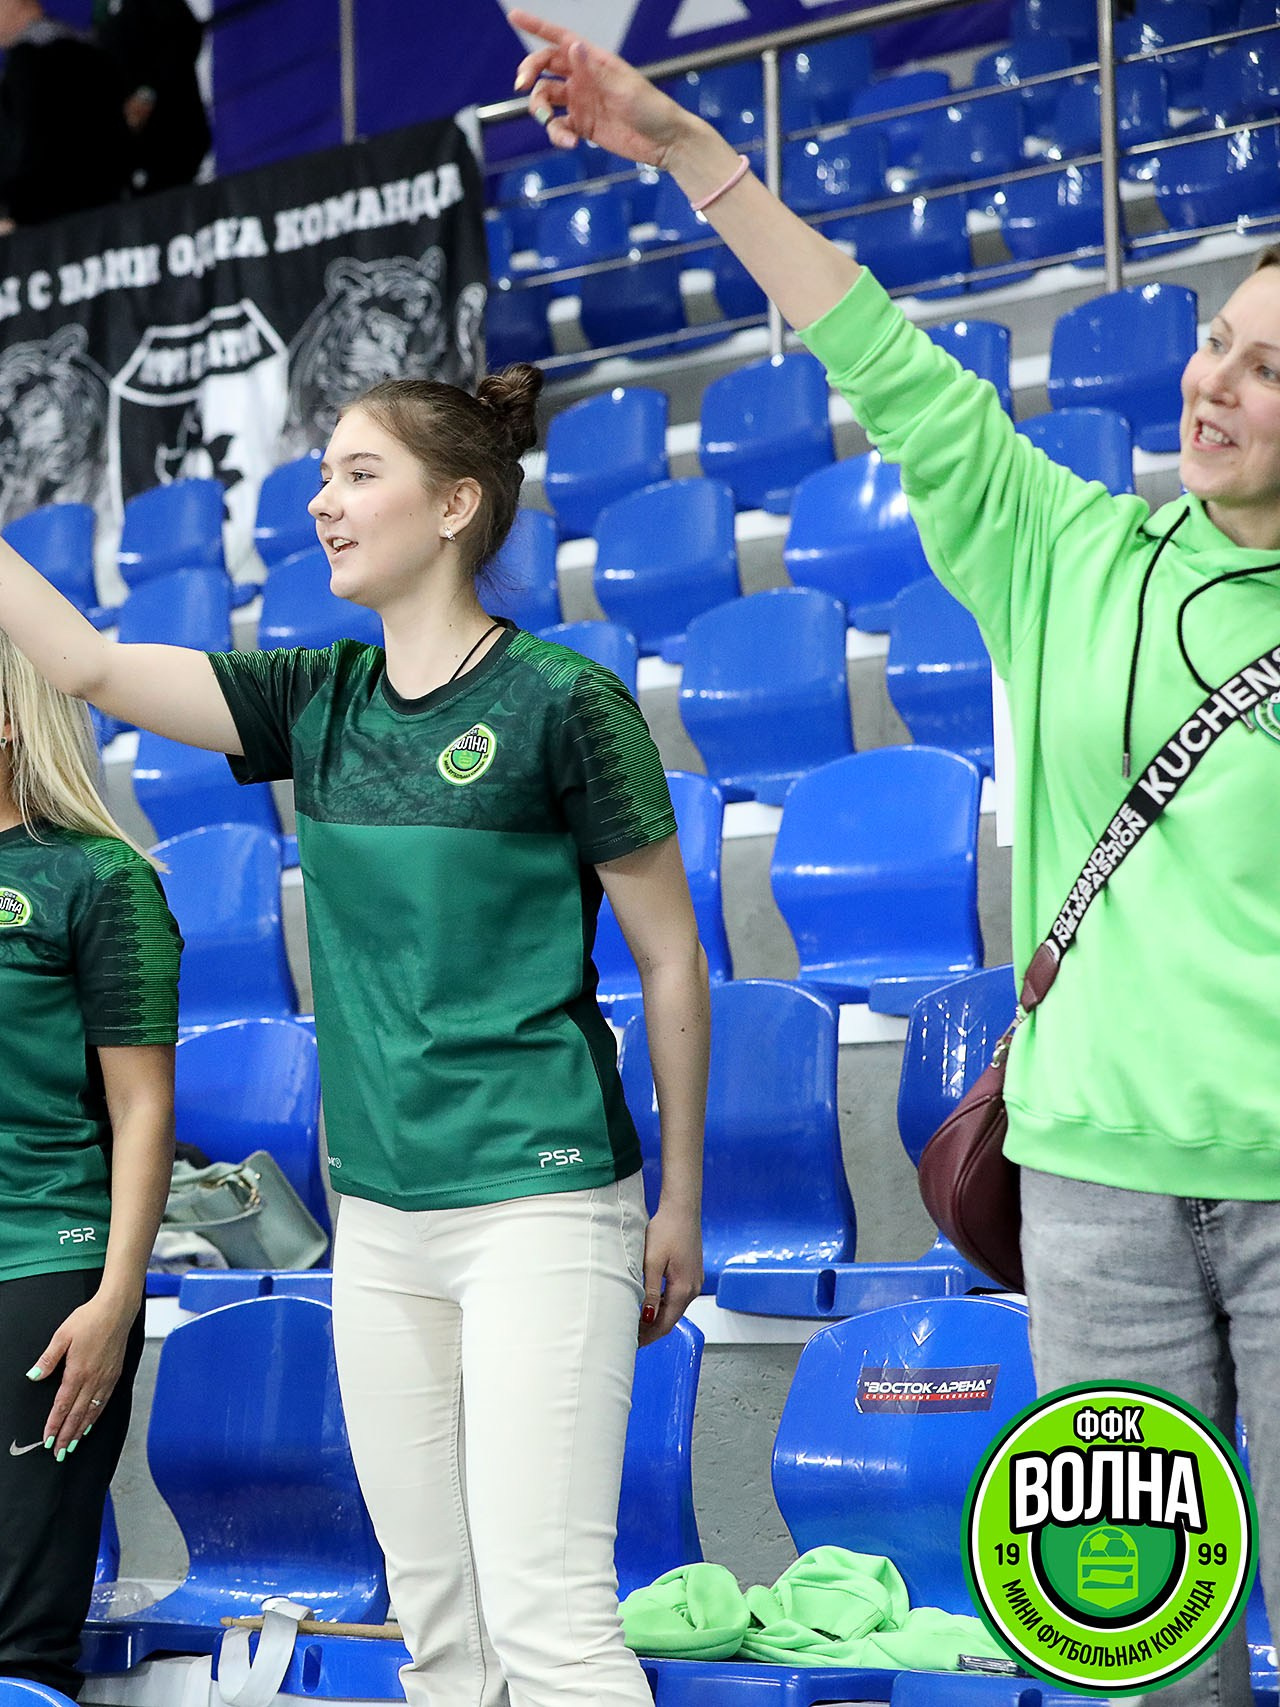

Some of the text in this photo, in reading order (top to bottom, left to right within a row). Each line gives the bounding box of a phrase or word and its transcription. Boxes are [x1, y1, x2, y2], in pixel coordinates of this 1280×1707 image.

[26, 269, 53, 311] С
[274, 162, 465, 253] КОМАНДА
[537, 1148, 584, 1168] PSR
[57, 1227, 96, 1245] PSR
[864, 1379, 992, 1394] "ВОСТОК-АРЕНА"
